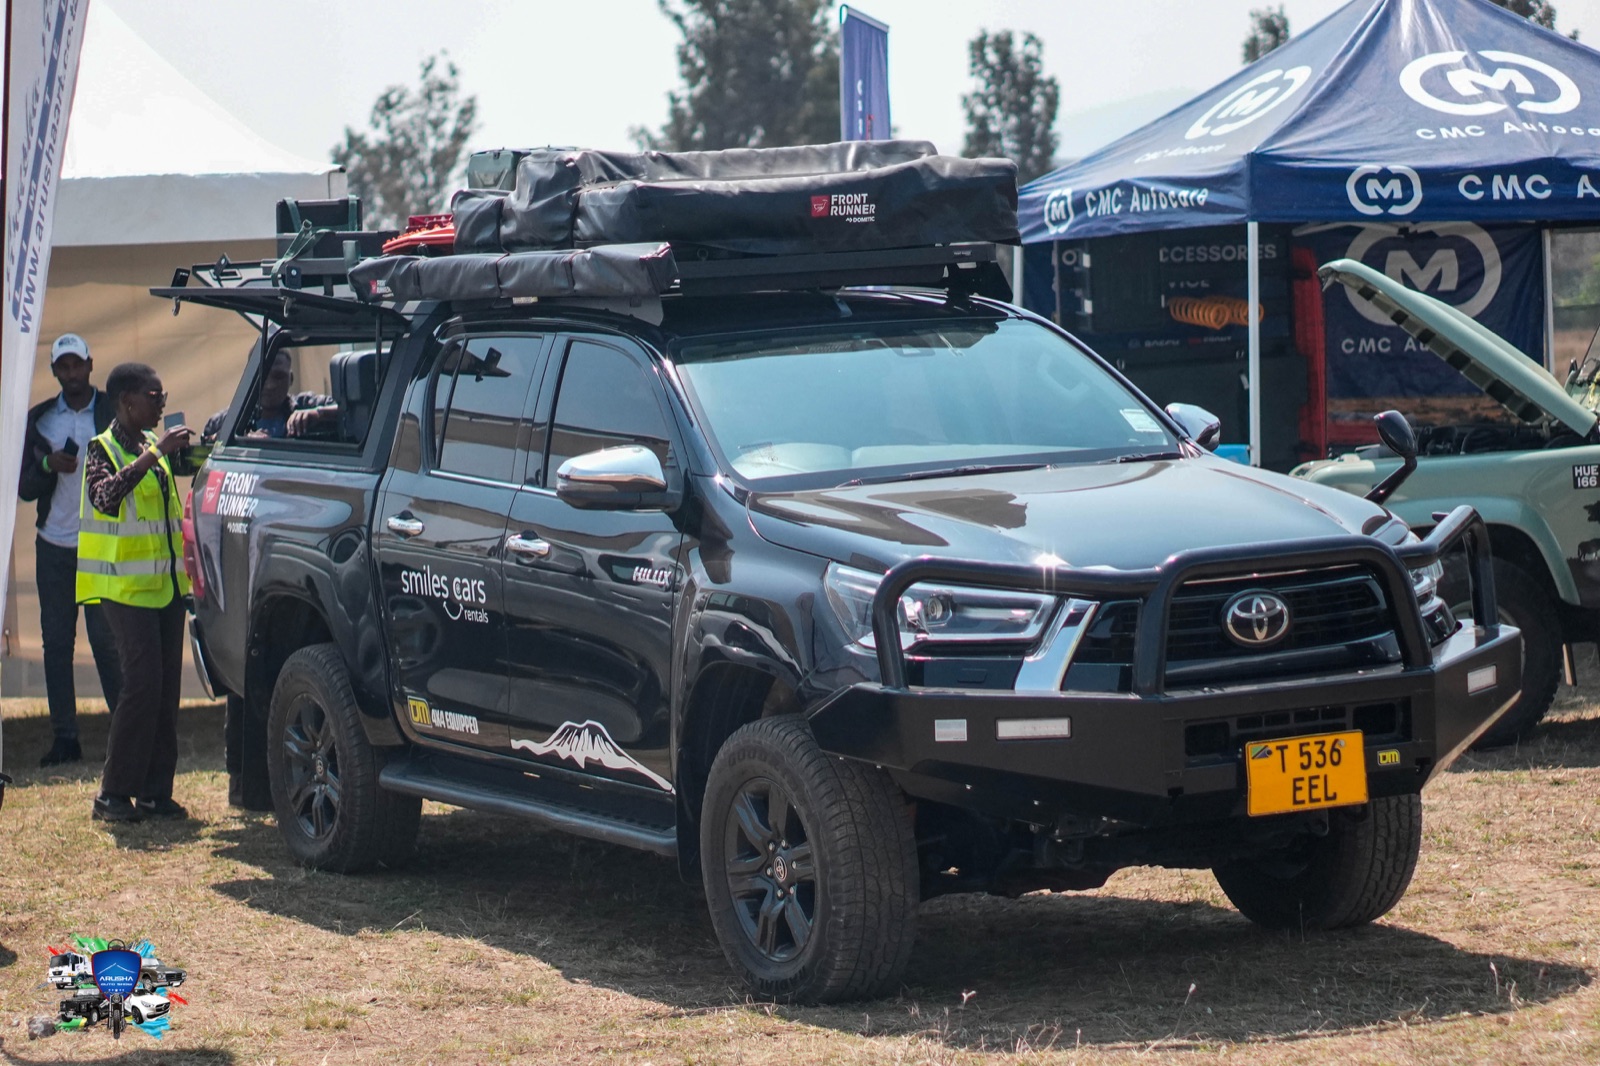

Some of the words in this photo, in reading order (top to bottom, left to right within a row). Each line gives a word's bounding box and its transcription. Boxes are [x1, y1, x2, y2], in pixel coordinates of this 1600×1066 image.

[1416, 125, 1486, 140] CMC
[1458, 174, 1552, 200] CMC
[830, 204, 876, 216] RUNNER
[831, 193, 868, 205] FRONT
[1085, 187, 1123, 218] CMC
[1129, 186, 1209, 213] Autocare
[1341, 337, 1391, 354] CMC
[1574, 465, 1599, 477] HUE
[1577, 476, 1597, 488] 166
[221, 471, 260, 495] FRONT
[216, 493, 259, 518] RUNNER
[401, 564, 449, 599] smiles
[452, 576, 486, 604] cars
[632, 566, 672, 587] HILUX
[464, 608, 489, 623] rentals
[444, 711, 479, 735] EQUIPPED
[1276, 745, 1289, 773] T
[1299, 738, 1342, 770] 536
[1292, 774, 1337, 805] EEL
